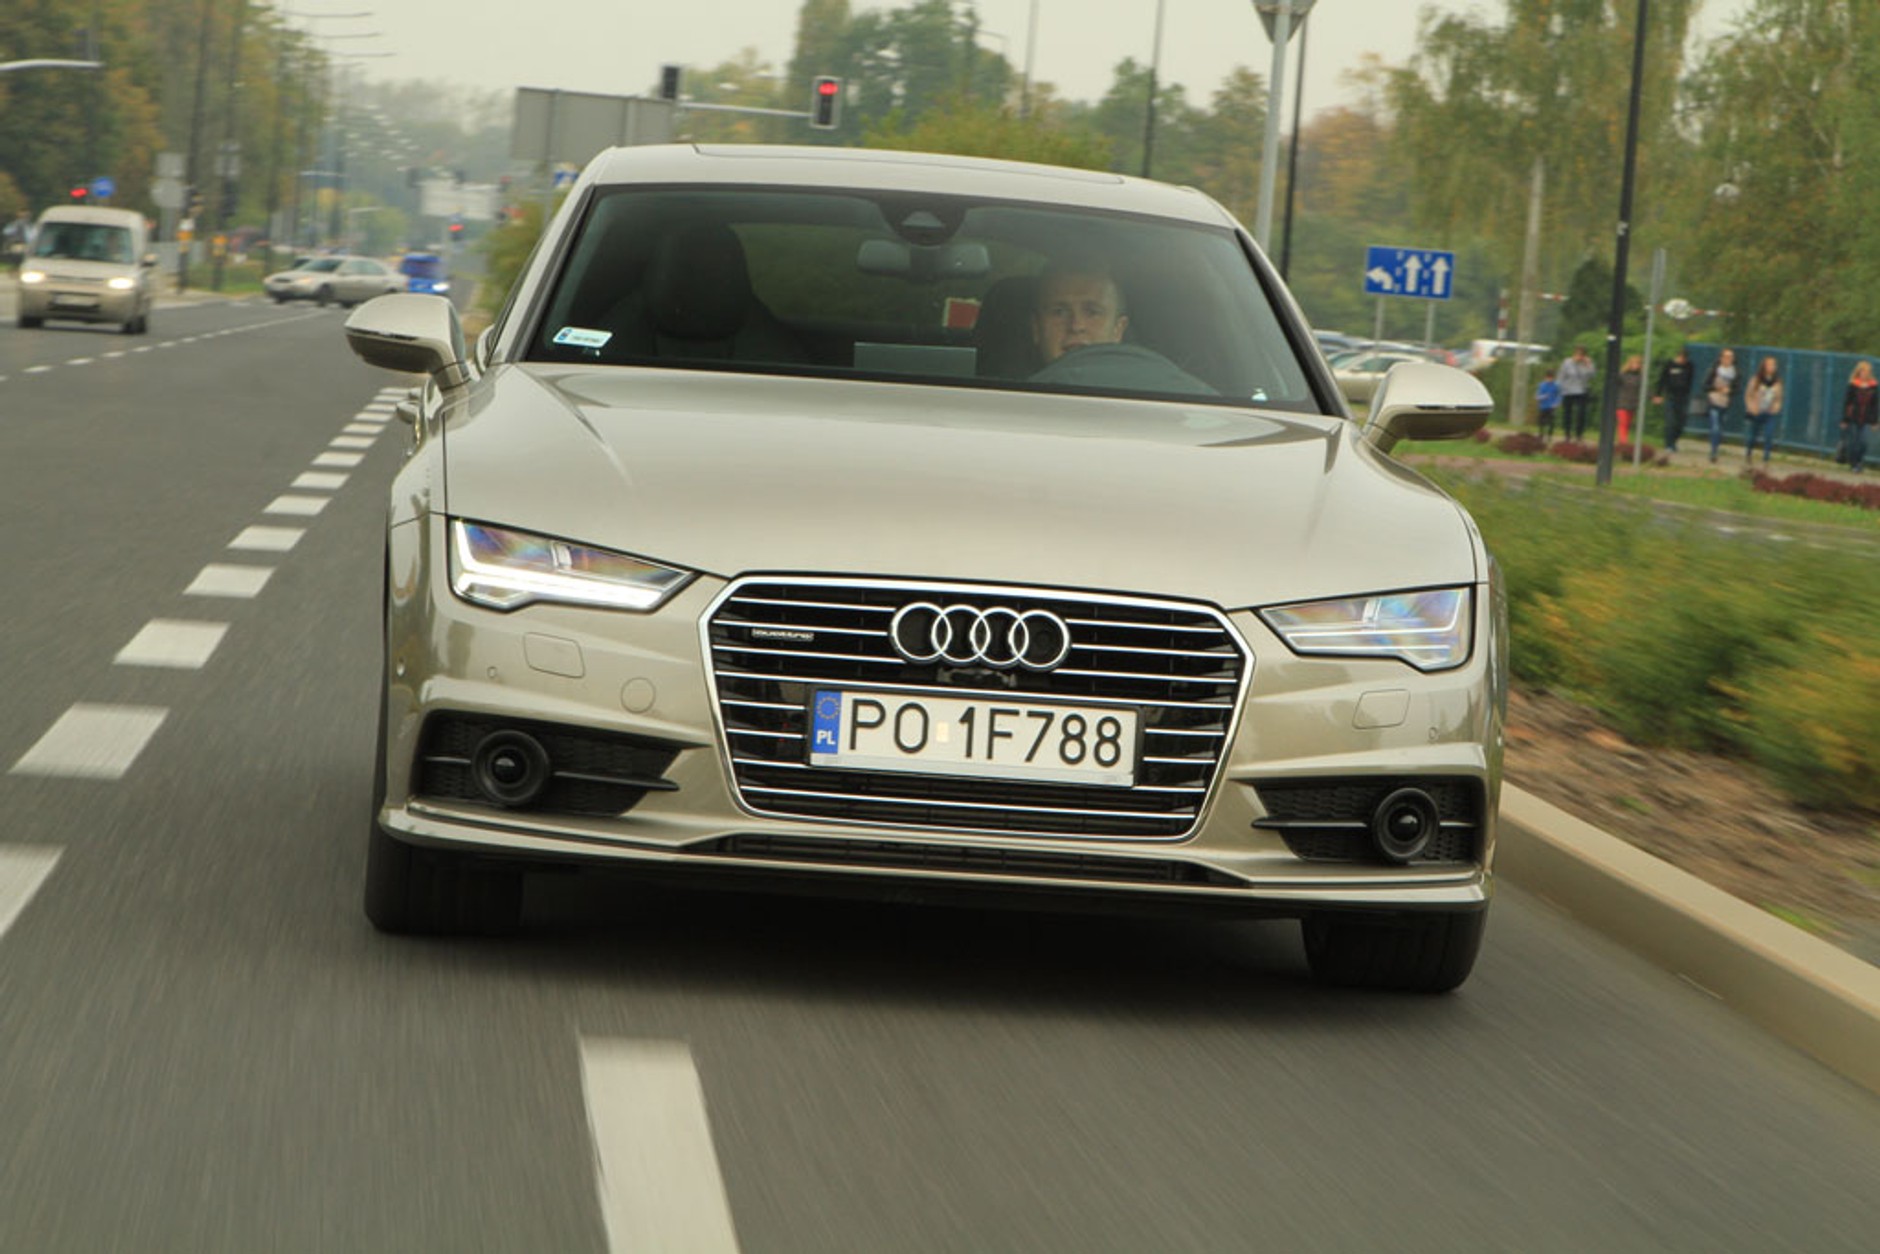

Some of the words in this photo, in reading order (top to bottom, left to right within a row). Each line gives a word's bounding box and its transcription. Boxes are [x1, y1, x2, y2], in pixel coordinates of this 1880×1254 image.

[816, 729, 837, 746] PL
[849, 698, 930, 754] PO
[958, 706, 1122, 768] 1F788
